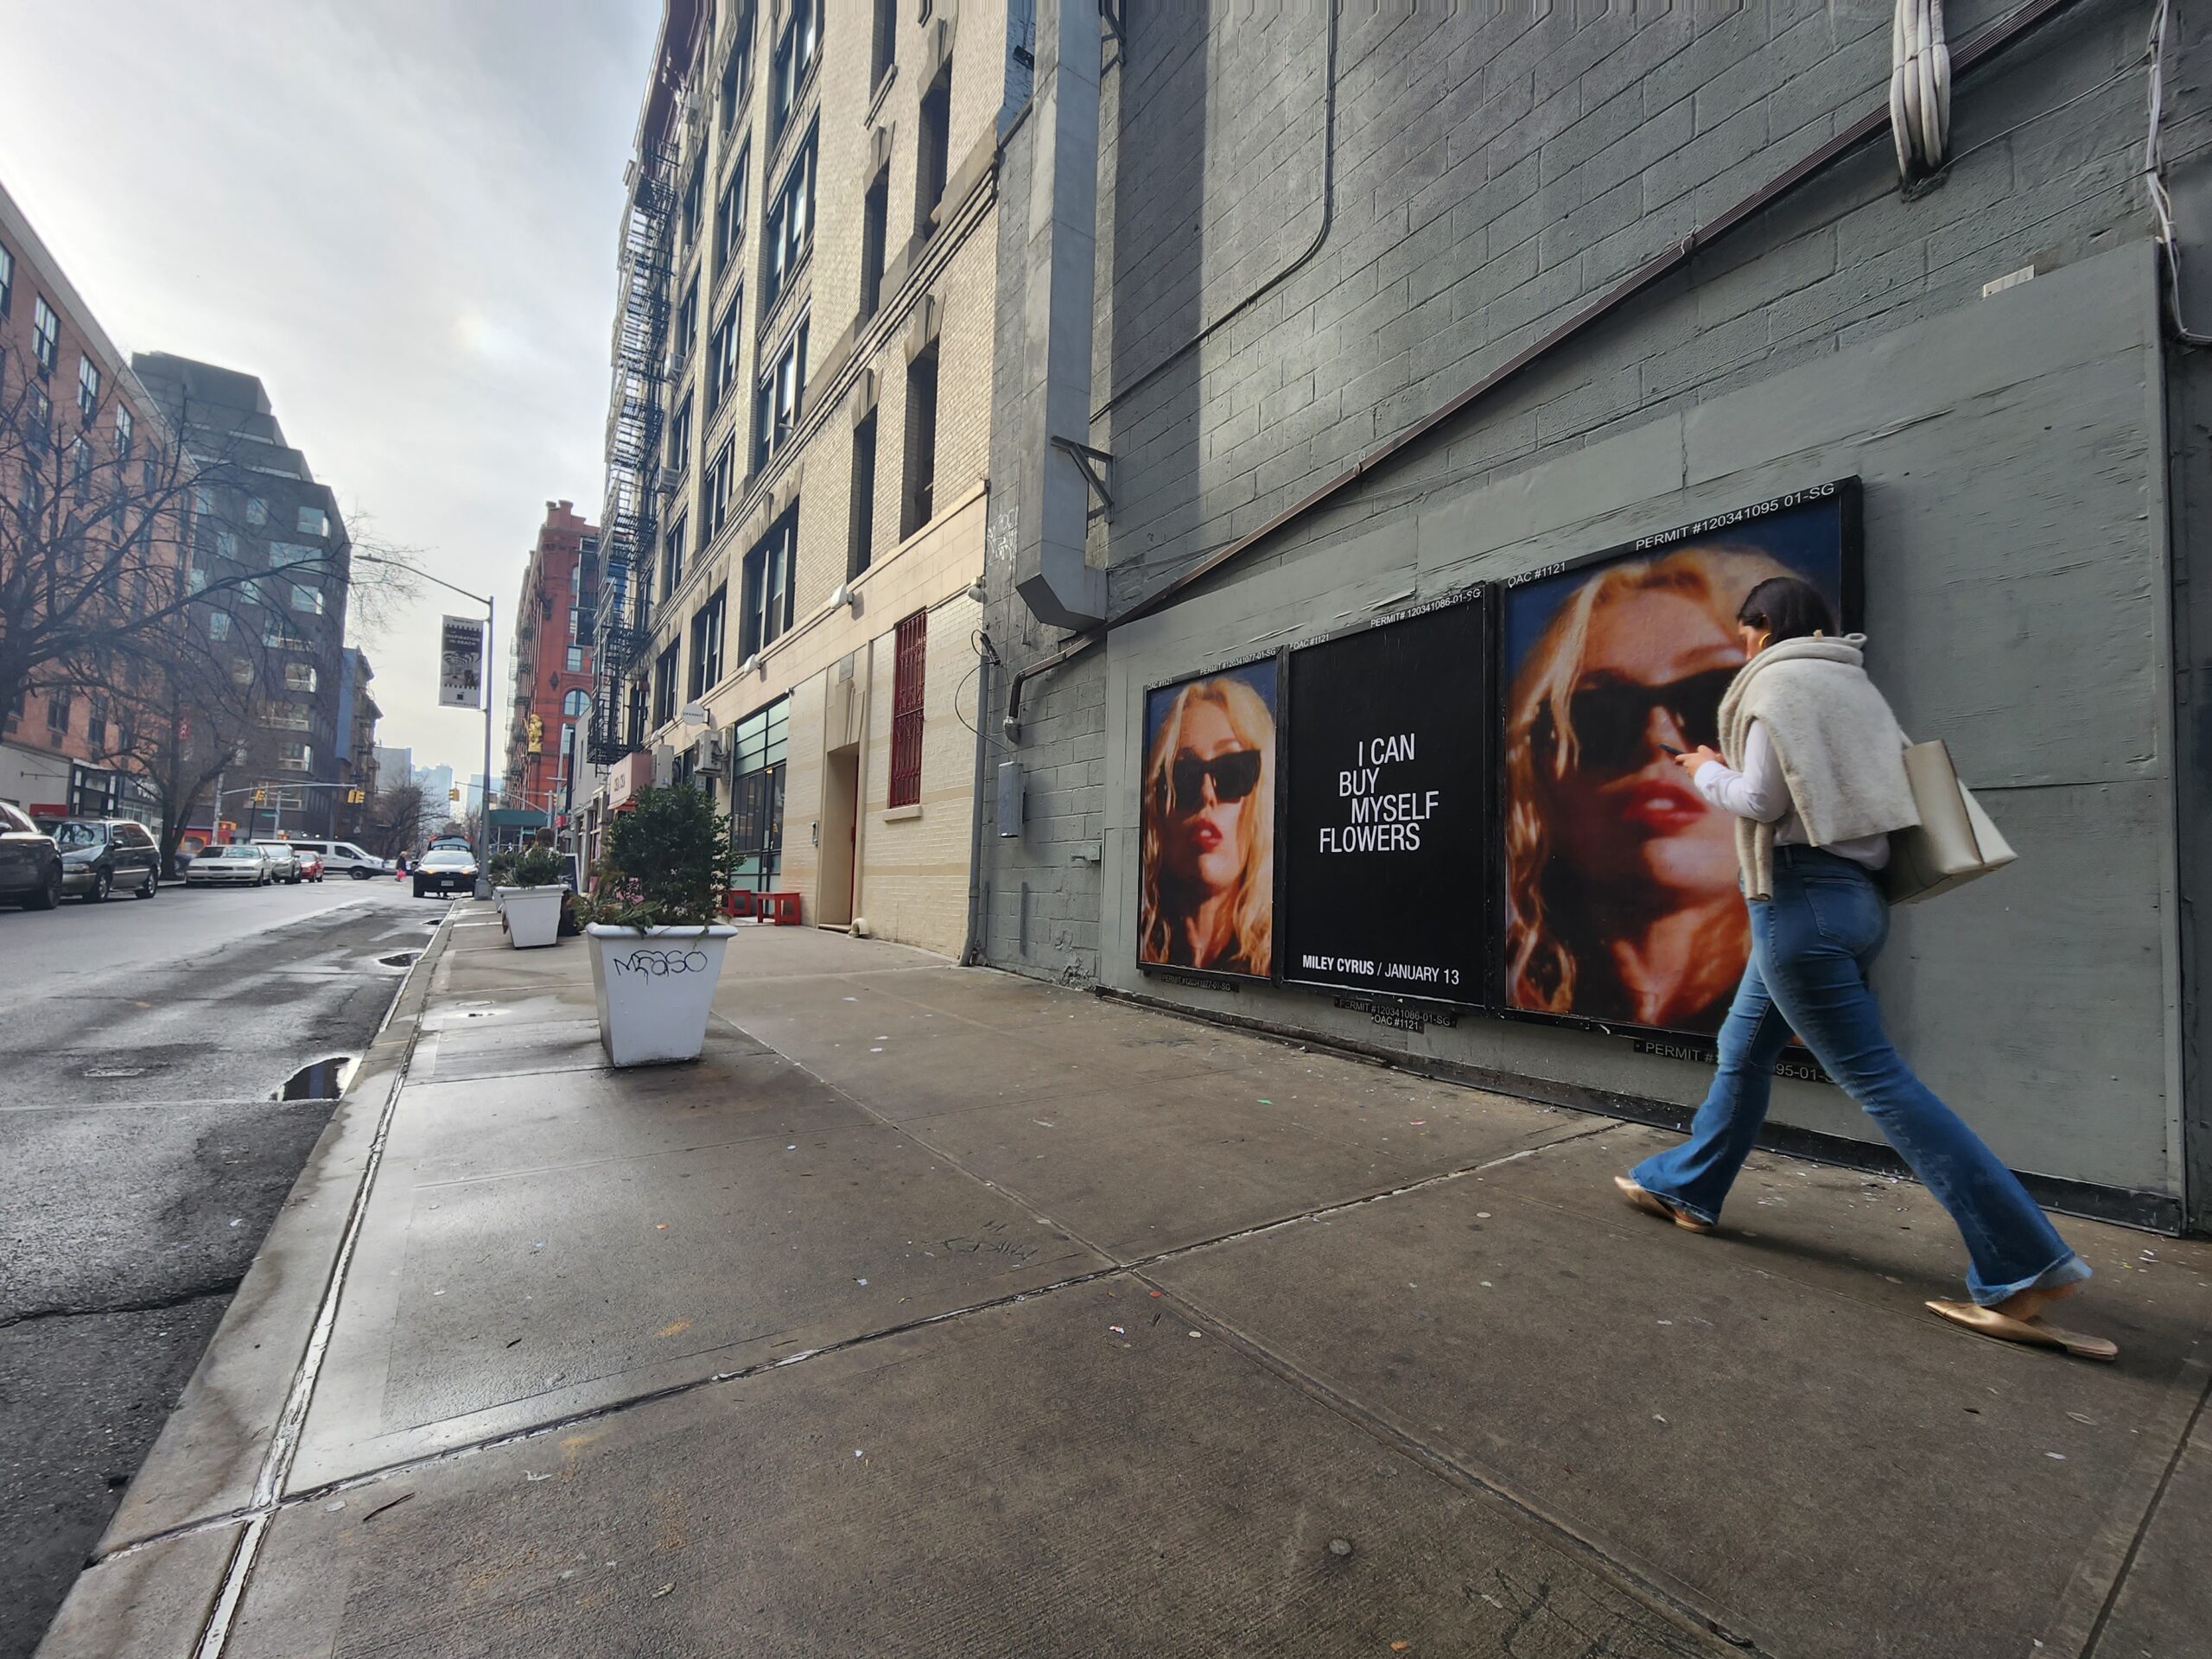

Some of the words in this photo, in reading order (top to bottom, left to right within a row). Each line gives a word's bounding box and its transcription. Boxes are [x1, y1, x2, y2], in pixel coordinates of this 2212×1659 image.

[1636, 526, 1689, 551] PERMIT
[1692, 499, 1779, 535] #120341095
[1535, 562, 1566, 579] #1121
[1370, 611, 1406, 628] PERMIT#
[1408, 588, 1482, 618] 120341086-01-SG
[1293, 639, 1309, 650] OAC
[1310, 633, 1329, 646] #1121
[1199, 664, 1221, 676] PERMIT
[1358, 741, 1363, 766] I
[1370, 733, 1415, 766] CAN
[1339, 766, 1380, 797] BUY
[1351, 791, 1440, 823] MYSELF
[1319, 823, 1421, 853] FLOWERS
[1302, 954, 1335, 971] MILEY
[1337, 958, 1375, 976] CYRUS
[1376, 962, 1382, 976] /
[1384, 963, 1440, 983] JANUARY
[1444, 969, 1459, 985] 13
[1339, 999, 1370, 1012] PERMIT
[1374, 1014, 1393, 1026] OAC
[1394, 1018, 1419, 1030] #1121
[1645, 1042, 1701, 1061] PERMIT
